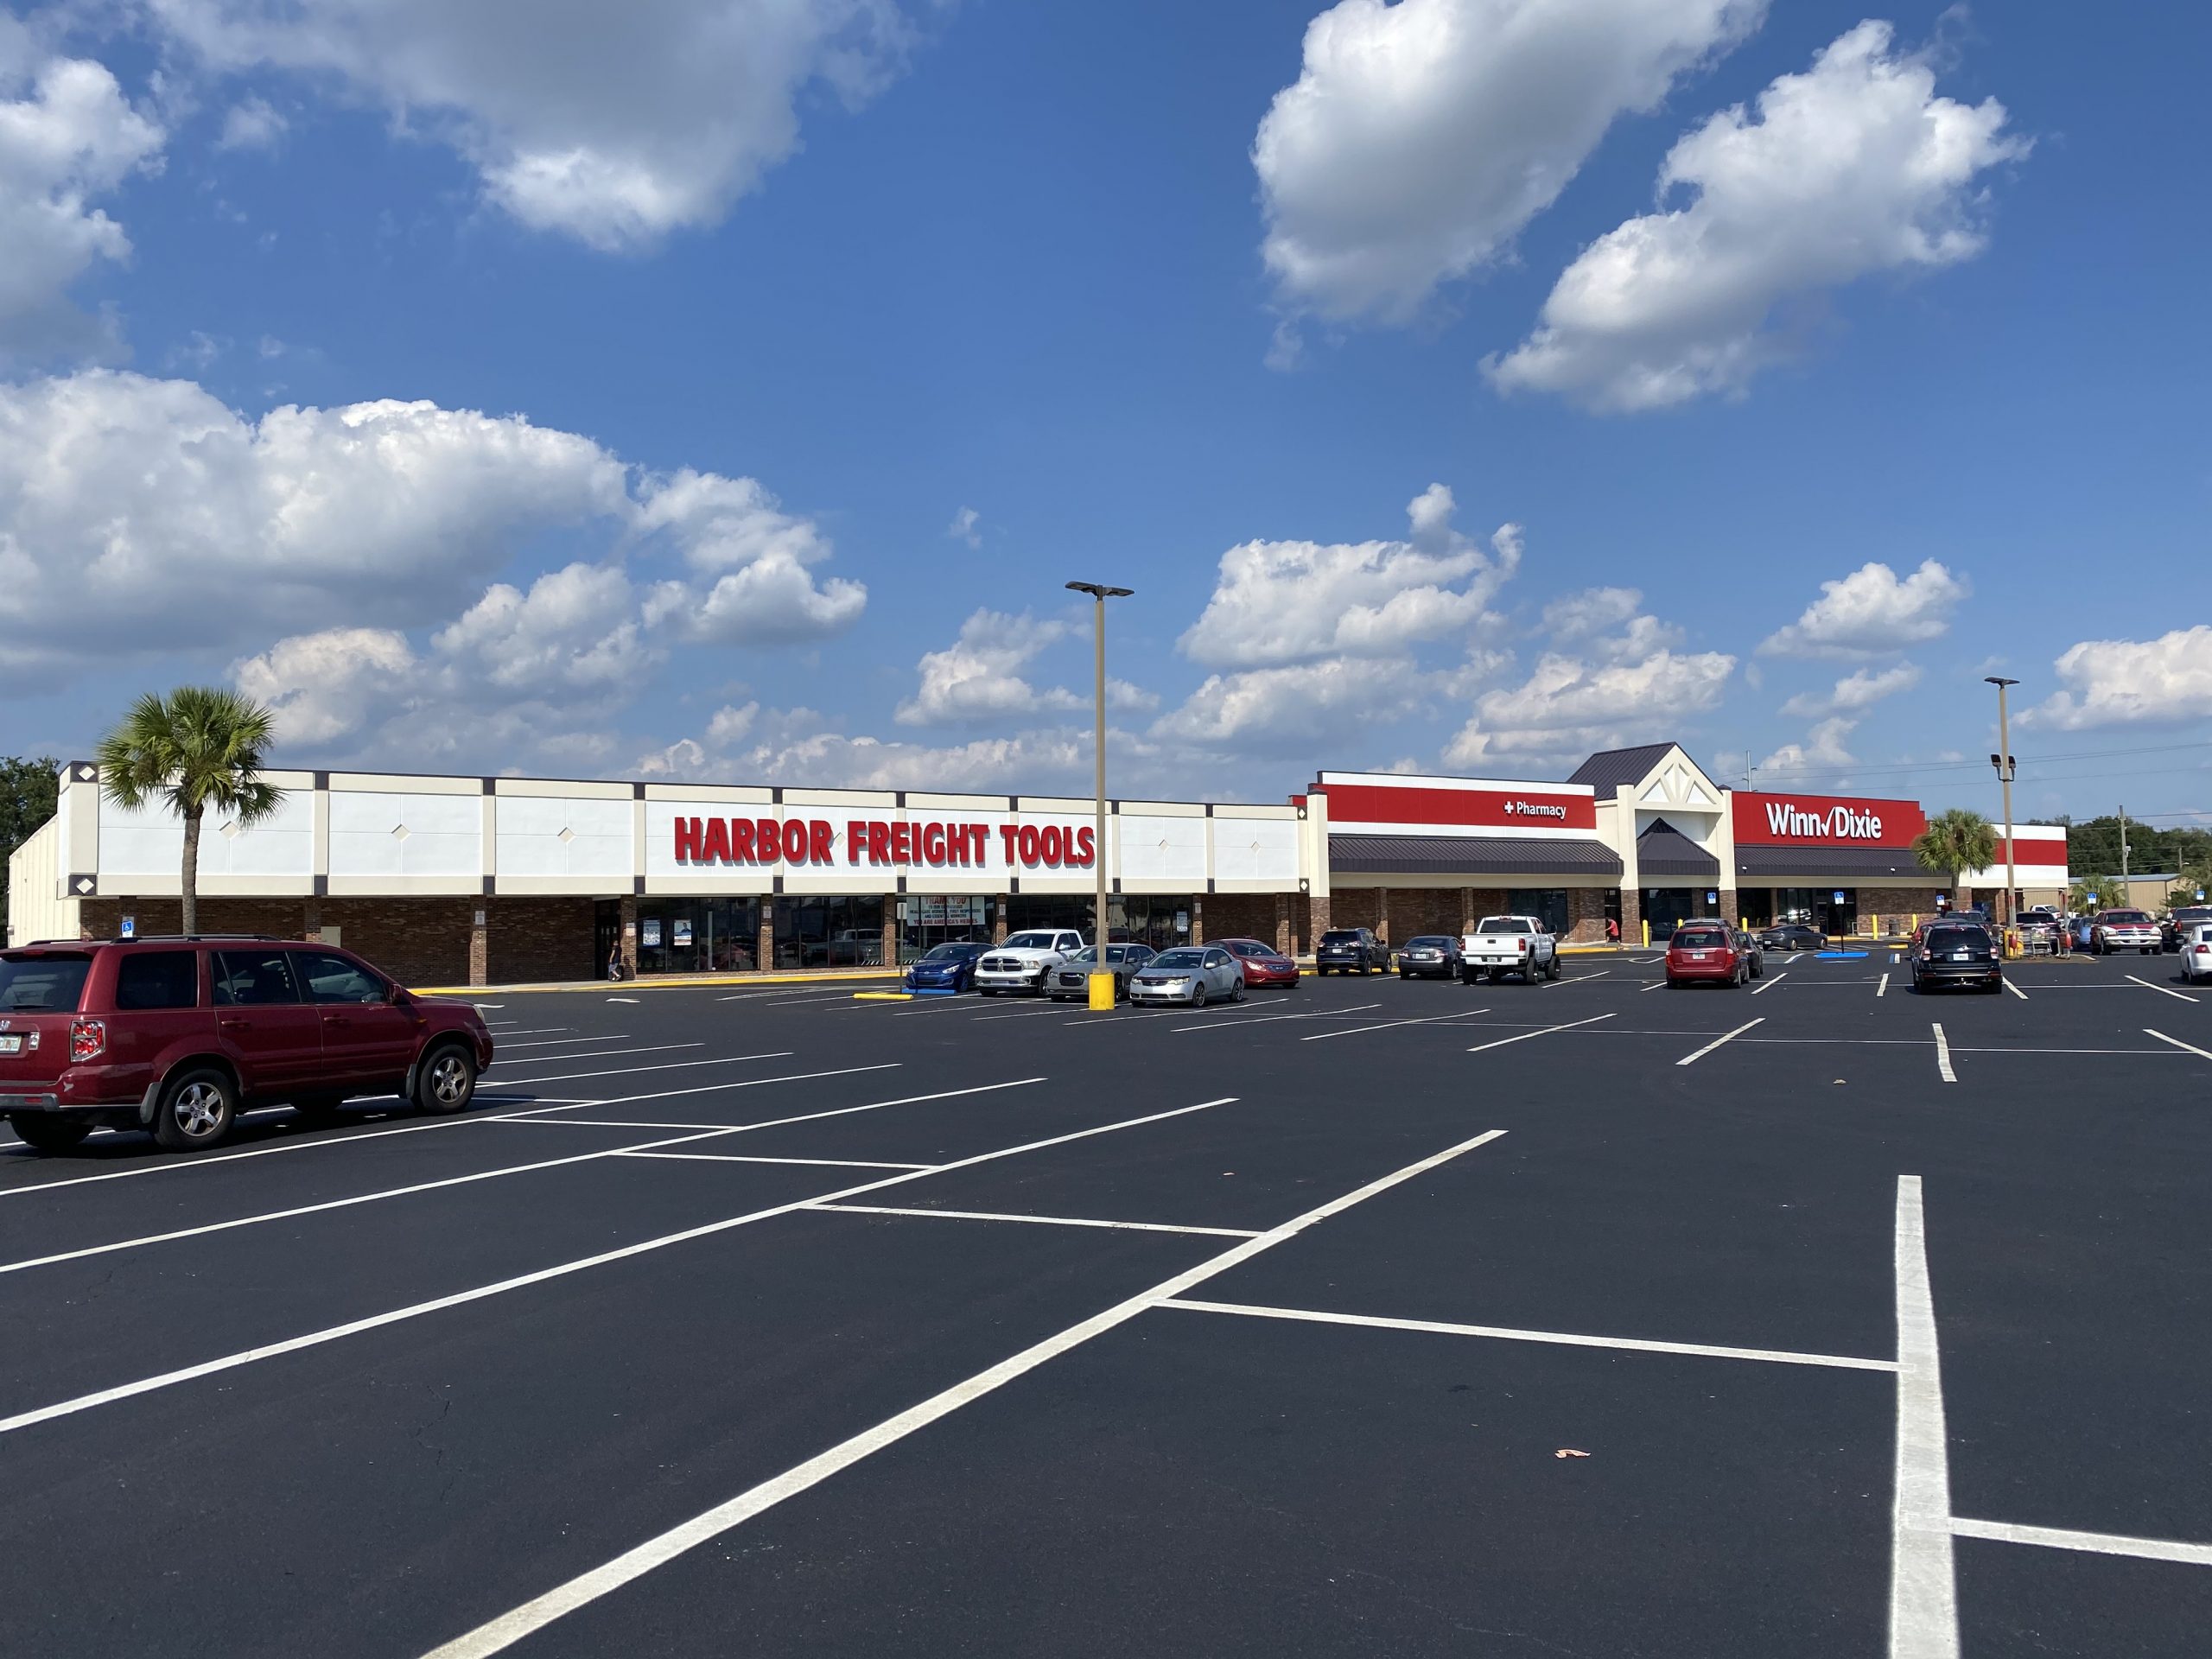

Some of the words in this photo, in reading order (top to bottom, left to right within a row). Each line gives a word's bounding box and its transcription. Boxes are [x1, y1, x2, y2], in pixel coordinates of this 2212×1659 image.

[1517, 802, 1566, 819] Pharmacy
[1766, 803, 1821, 836] Winn
[1835, 807, 1881, 838] Dixie
[675, 817, 832, 861] HARBOR
[848, 821, 989, 863] FREIGHT
[1000, 824, 1094, 864] TOOLS
